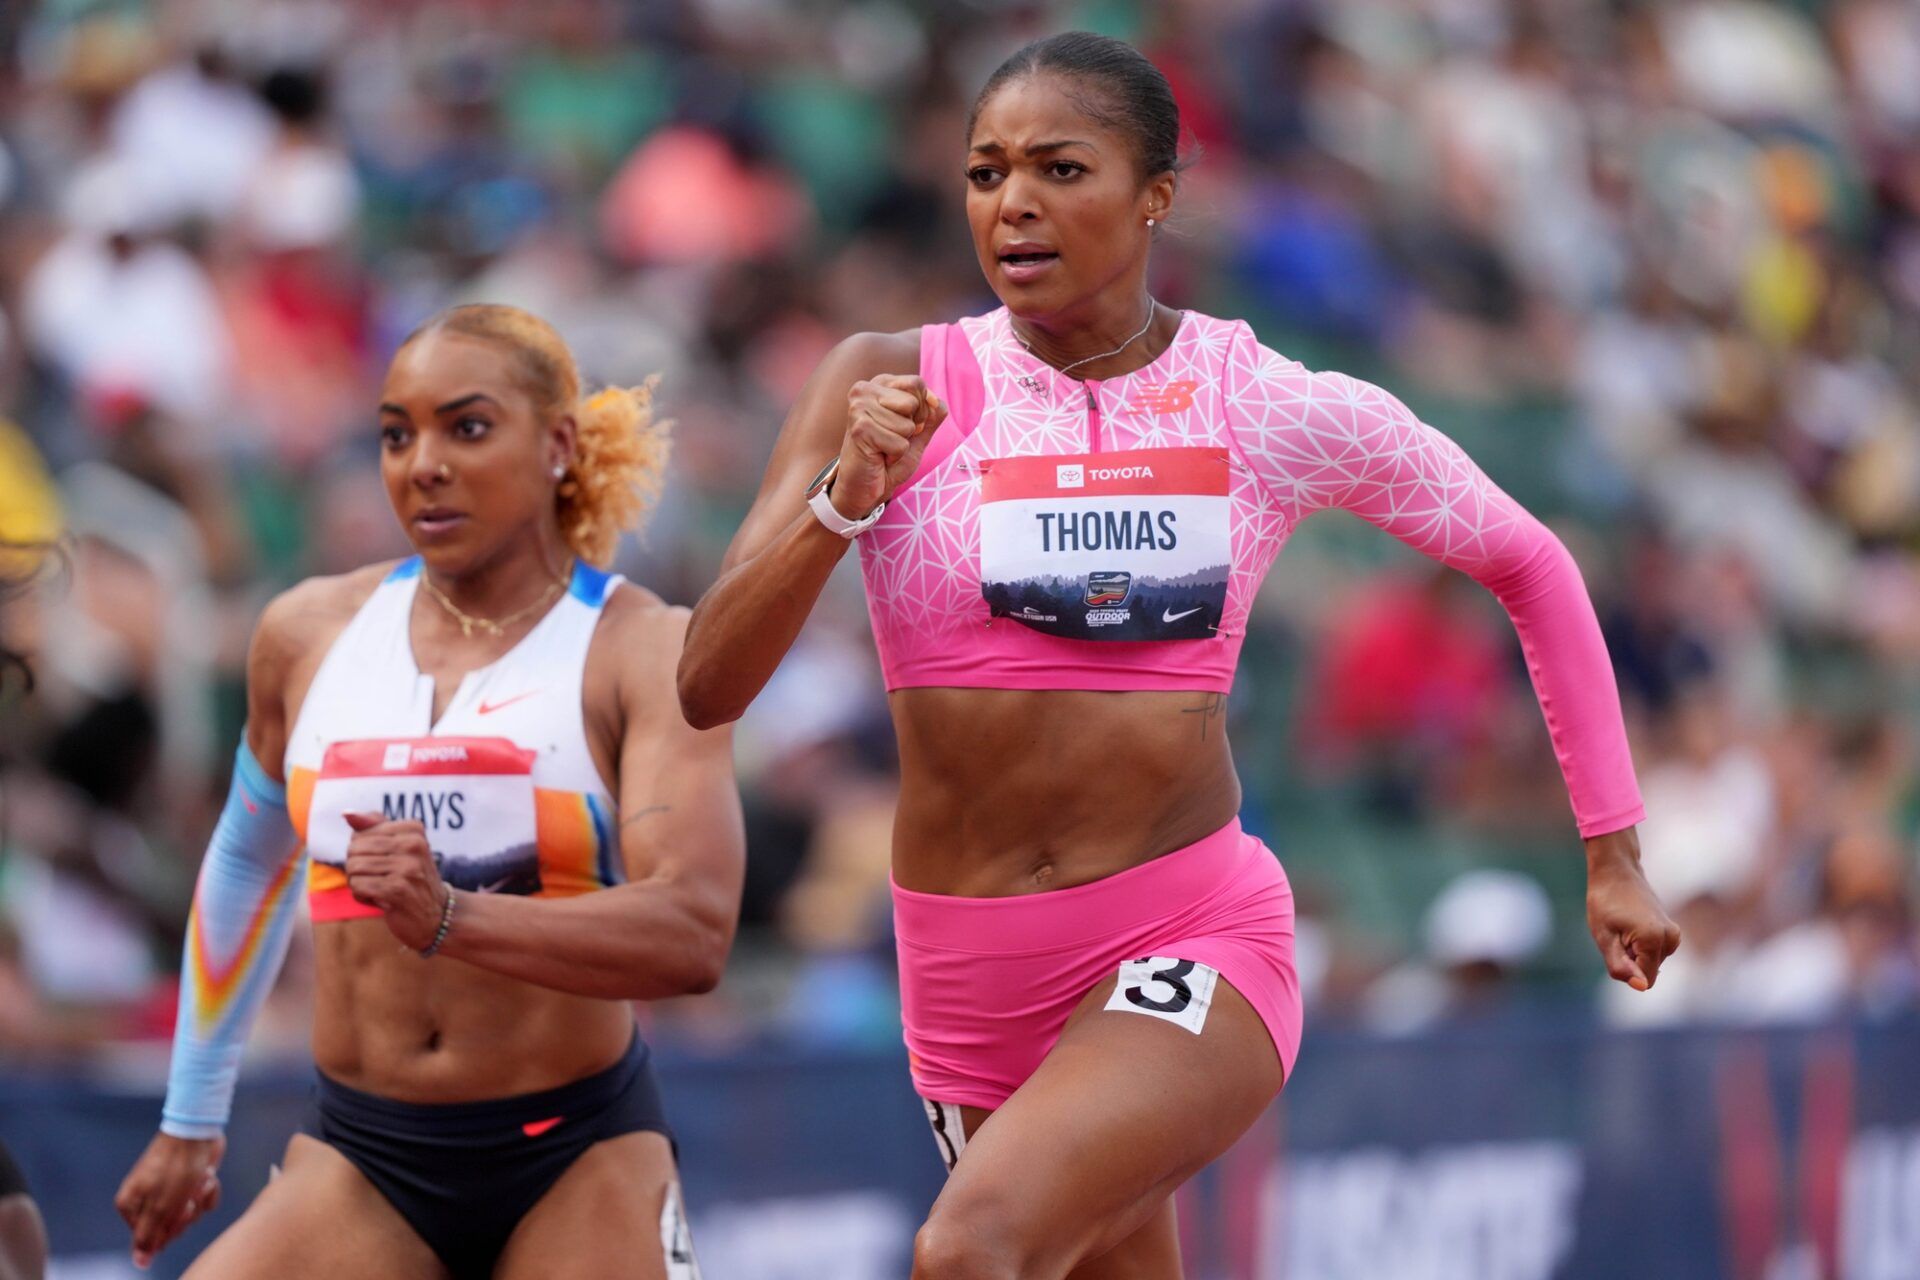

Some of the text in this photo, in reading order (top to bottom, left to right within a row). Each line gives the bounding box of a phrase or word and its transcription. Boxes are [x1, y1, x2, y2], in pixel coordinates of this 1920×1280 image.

[1088, 466, 1154, 481] TOYOTA
[1036, 510, 1177, 552] THOMAS
[1085, 612, 1131, 621] OUTDOOR
[412, 746, 469, 763] TOYOTA
[383, 792, 465, 830] MAYS
[1125, 955, 1196, 1013] 3
